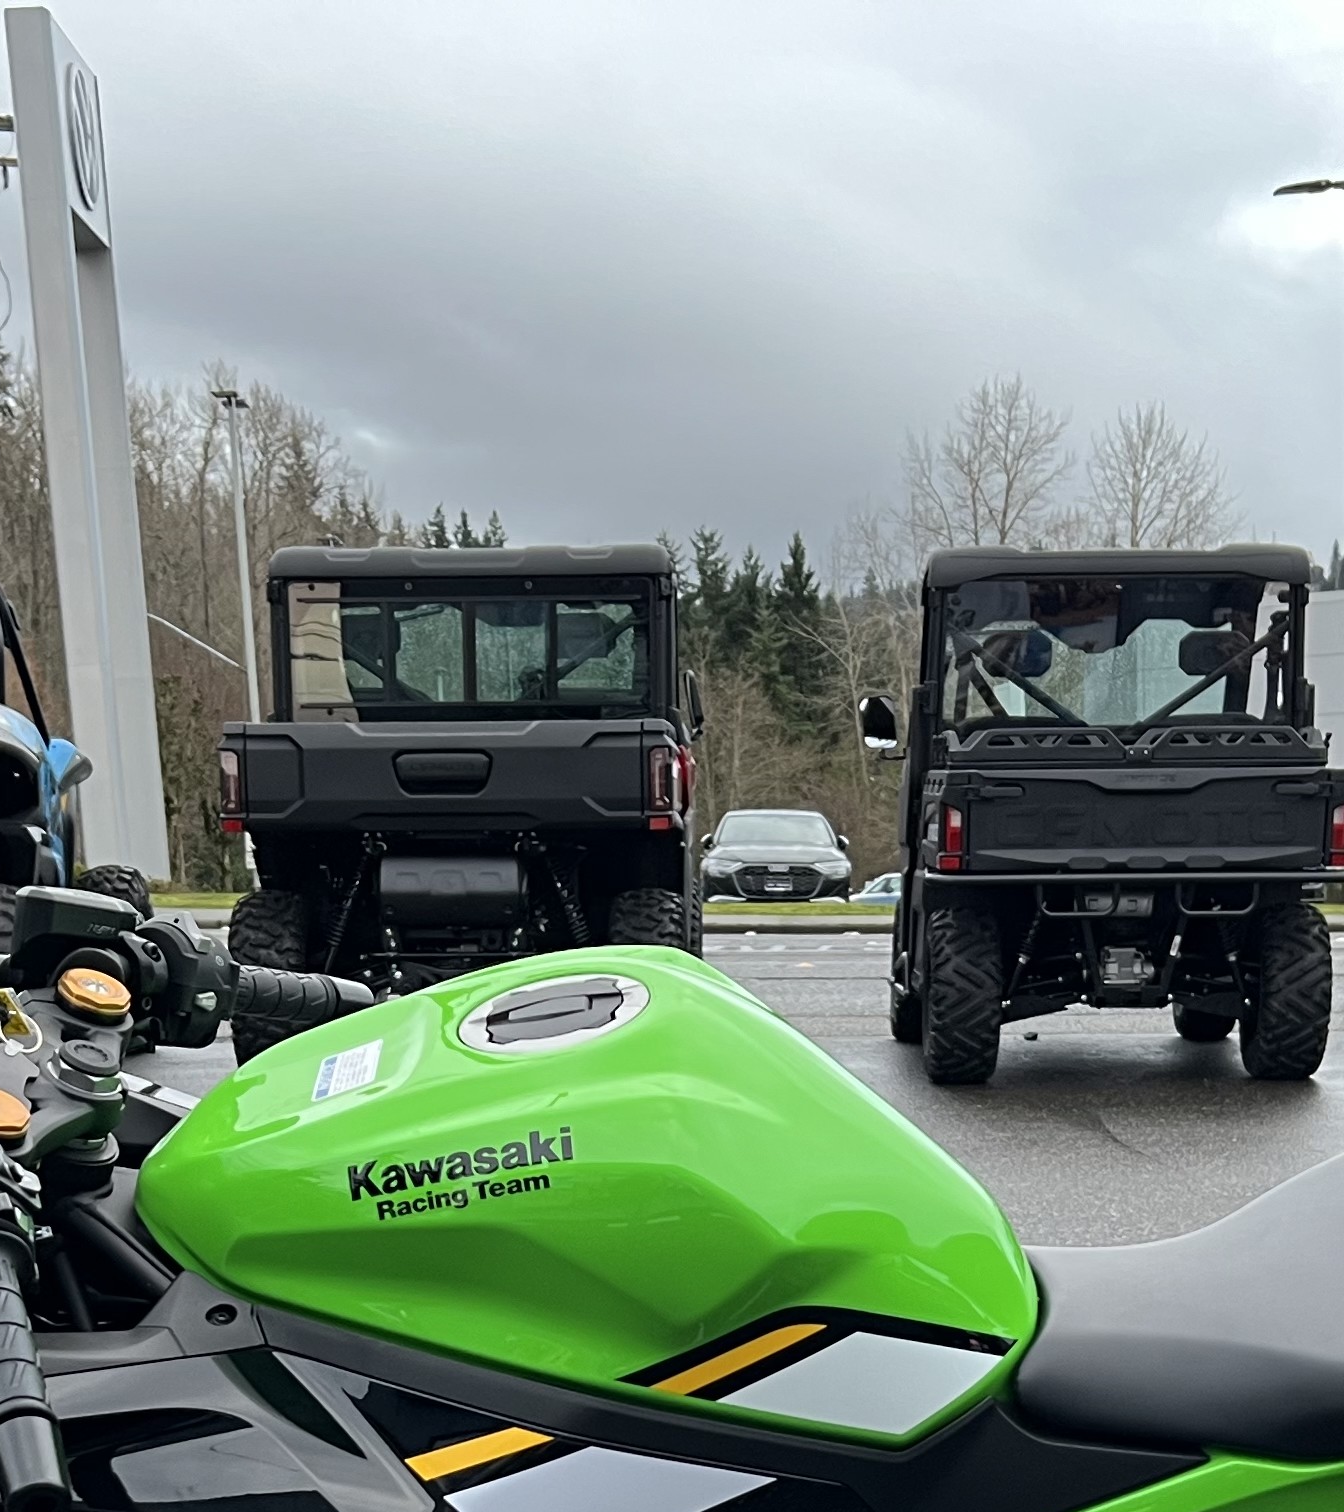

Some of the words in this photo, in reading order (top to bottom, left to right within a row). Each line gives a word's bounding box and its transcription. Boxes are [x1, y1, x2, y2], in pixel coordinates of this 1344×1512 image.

[994, 803, 1299, 847] CFMOTO
[346, 1126, 574, 1202] Kawasaki
[376, 1188, 469, 1221] Racing
[472, 1174, 551, 1200] Team
